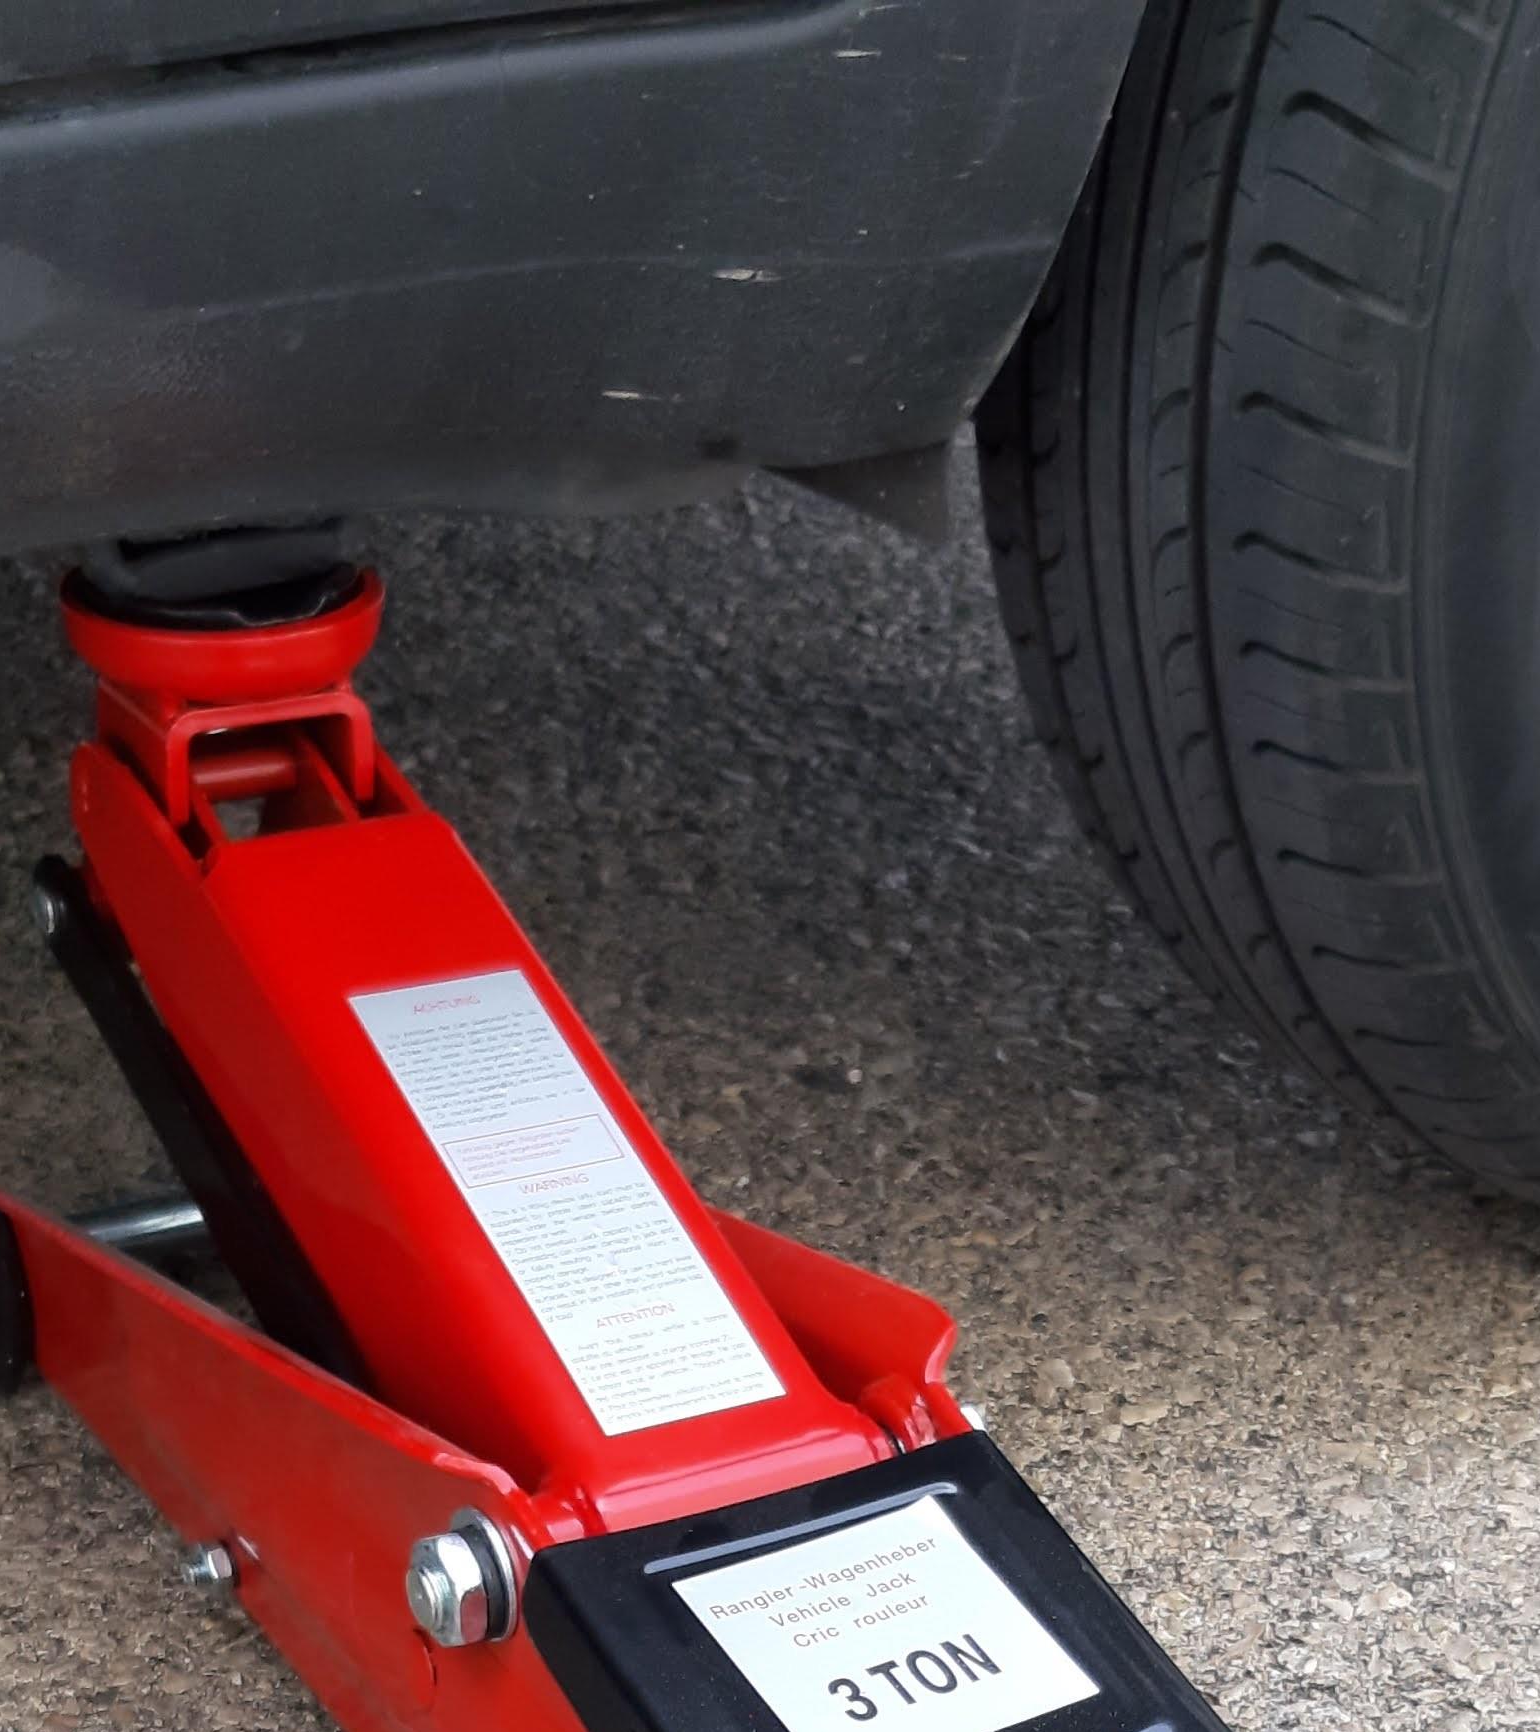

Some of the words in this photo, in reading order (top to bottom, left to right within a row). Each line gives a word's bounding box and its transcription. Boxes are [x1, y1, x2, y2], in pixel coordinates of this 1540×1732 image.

[518, 1173, 590, 1195] WARNING
[596, 1302, 677, 1329] ATTENTION
[769, 1594, 852, 1628] Vehicle
[866, 1571, 917, 1599] Jack
[793, 1625, 840, 1649] Cric
[853, 1594, 930, 1629] rouleur
[828, 1677, 879, 1723] 3
[867, 1633, 1002, 1705] TON
